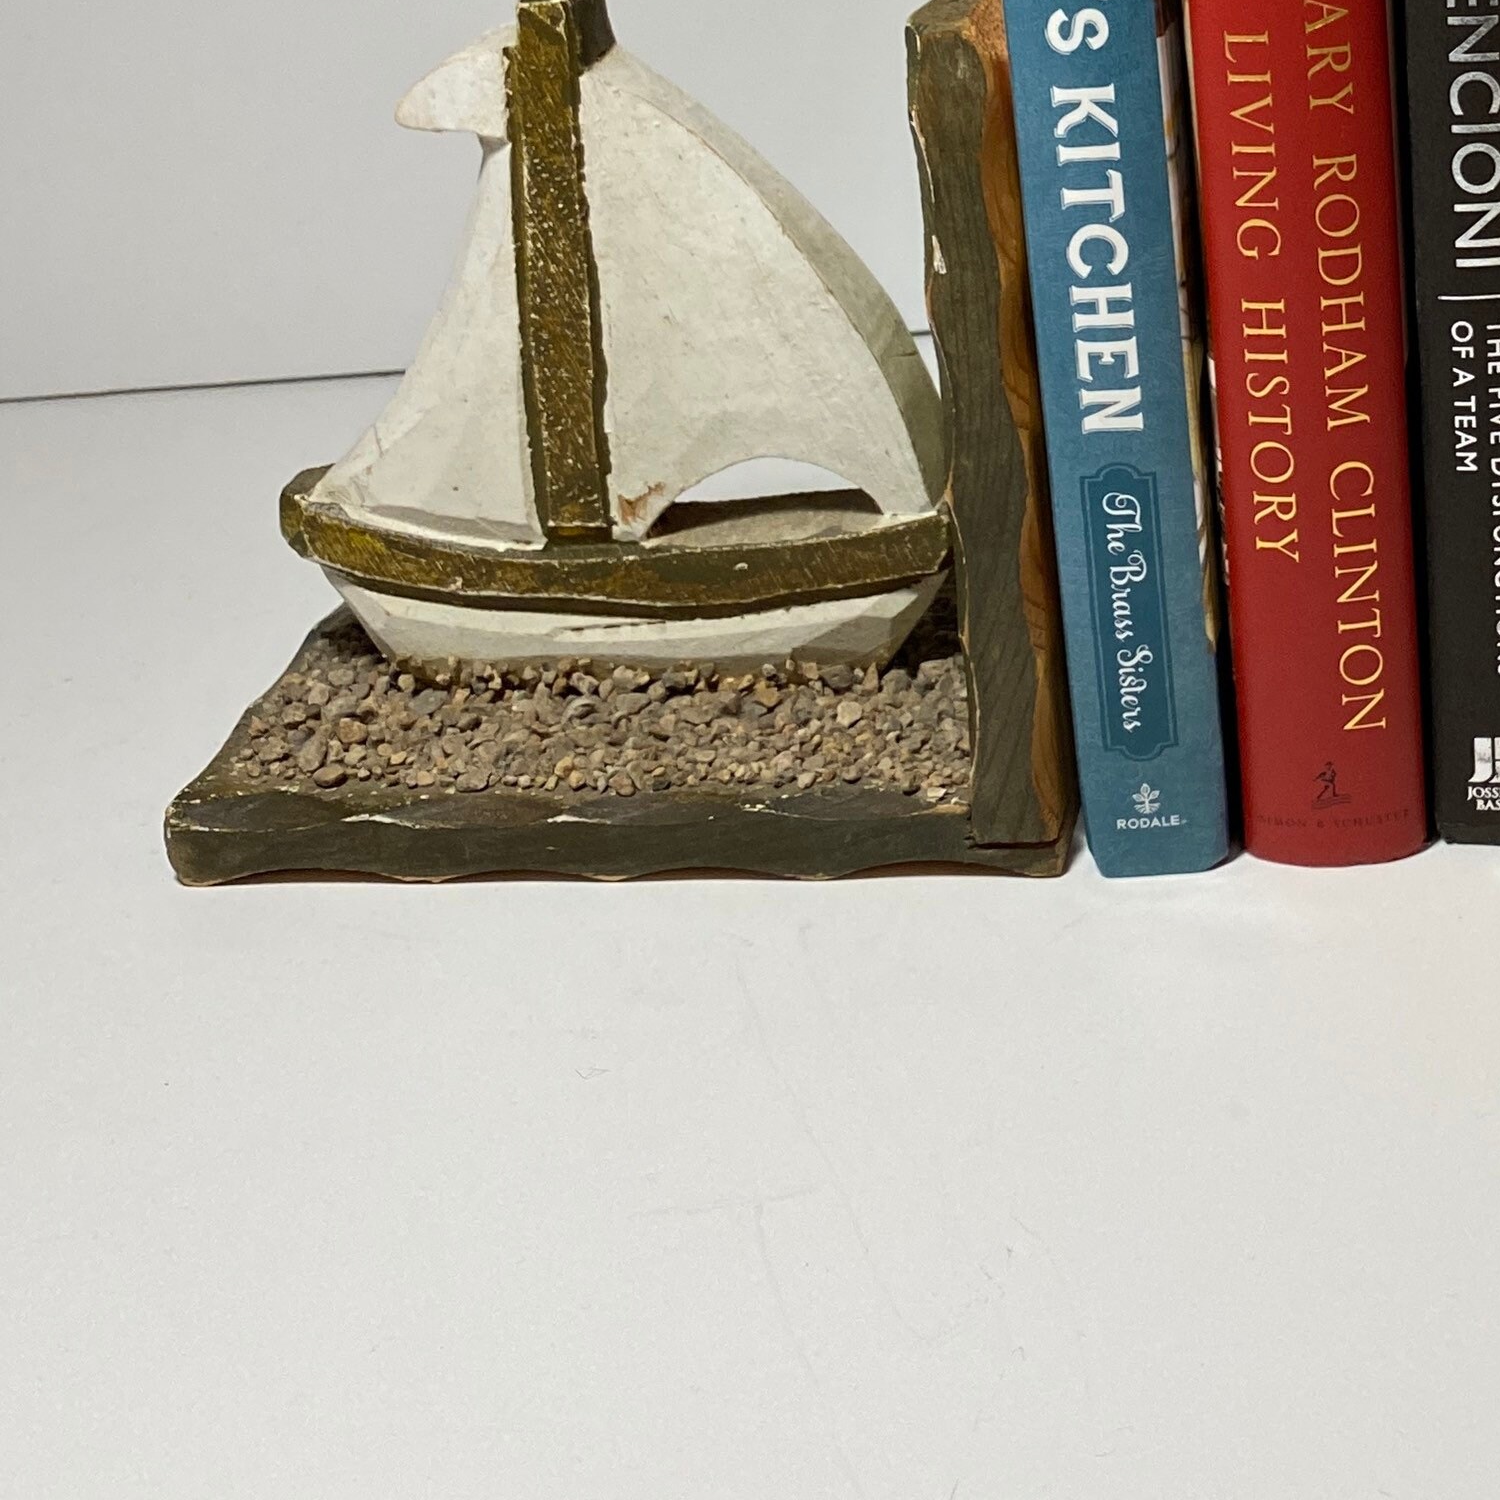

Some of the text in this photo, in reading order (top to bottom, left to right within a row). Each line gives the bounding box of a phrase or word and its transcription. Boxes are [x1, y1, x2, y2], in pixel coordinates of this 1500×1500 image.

[1051, 83, 1145, 435] KITCHEN
[1223, 30, 1300, 563] LIVING HISTORY
[1311, 154, 1370, 431] RODHAM
[1451, 320, 1478, 472] OF A TEAM
[1102, 492, 1153, 733] The Brass Sisters
[1330, 461, 1386, 731] CLINTON
[1116, 815, 1180, 830] RODALE
